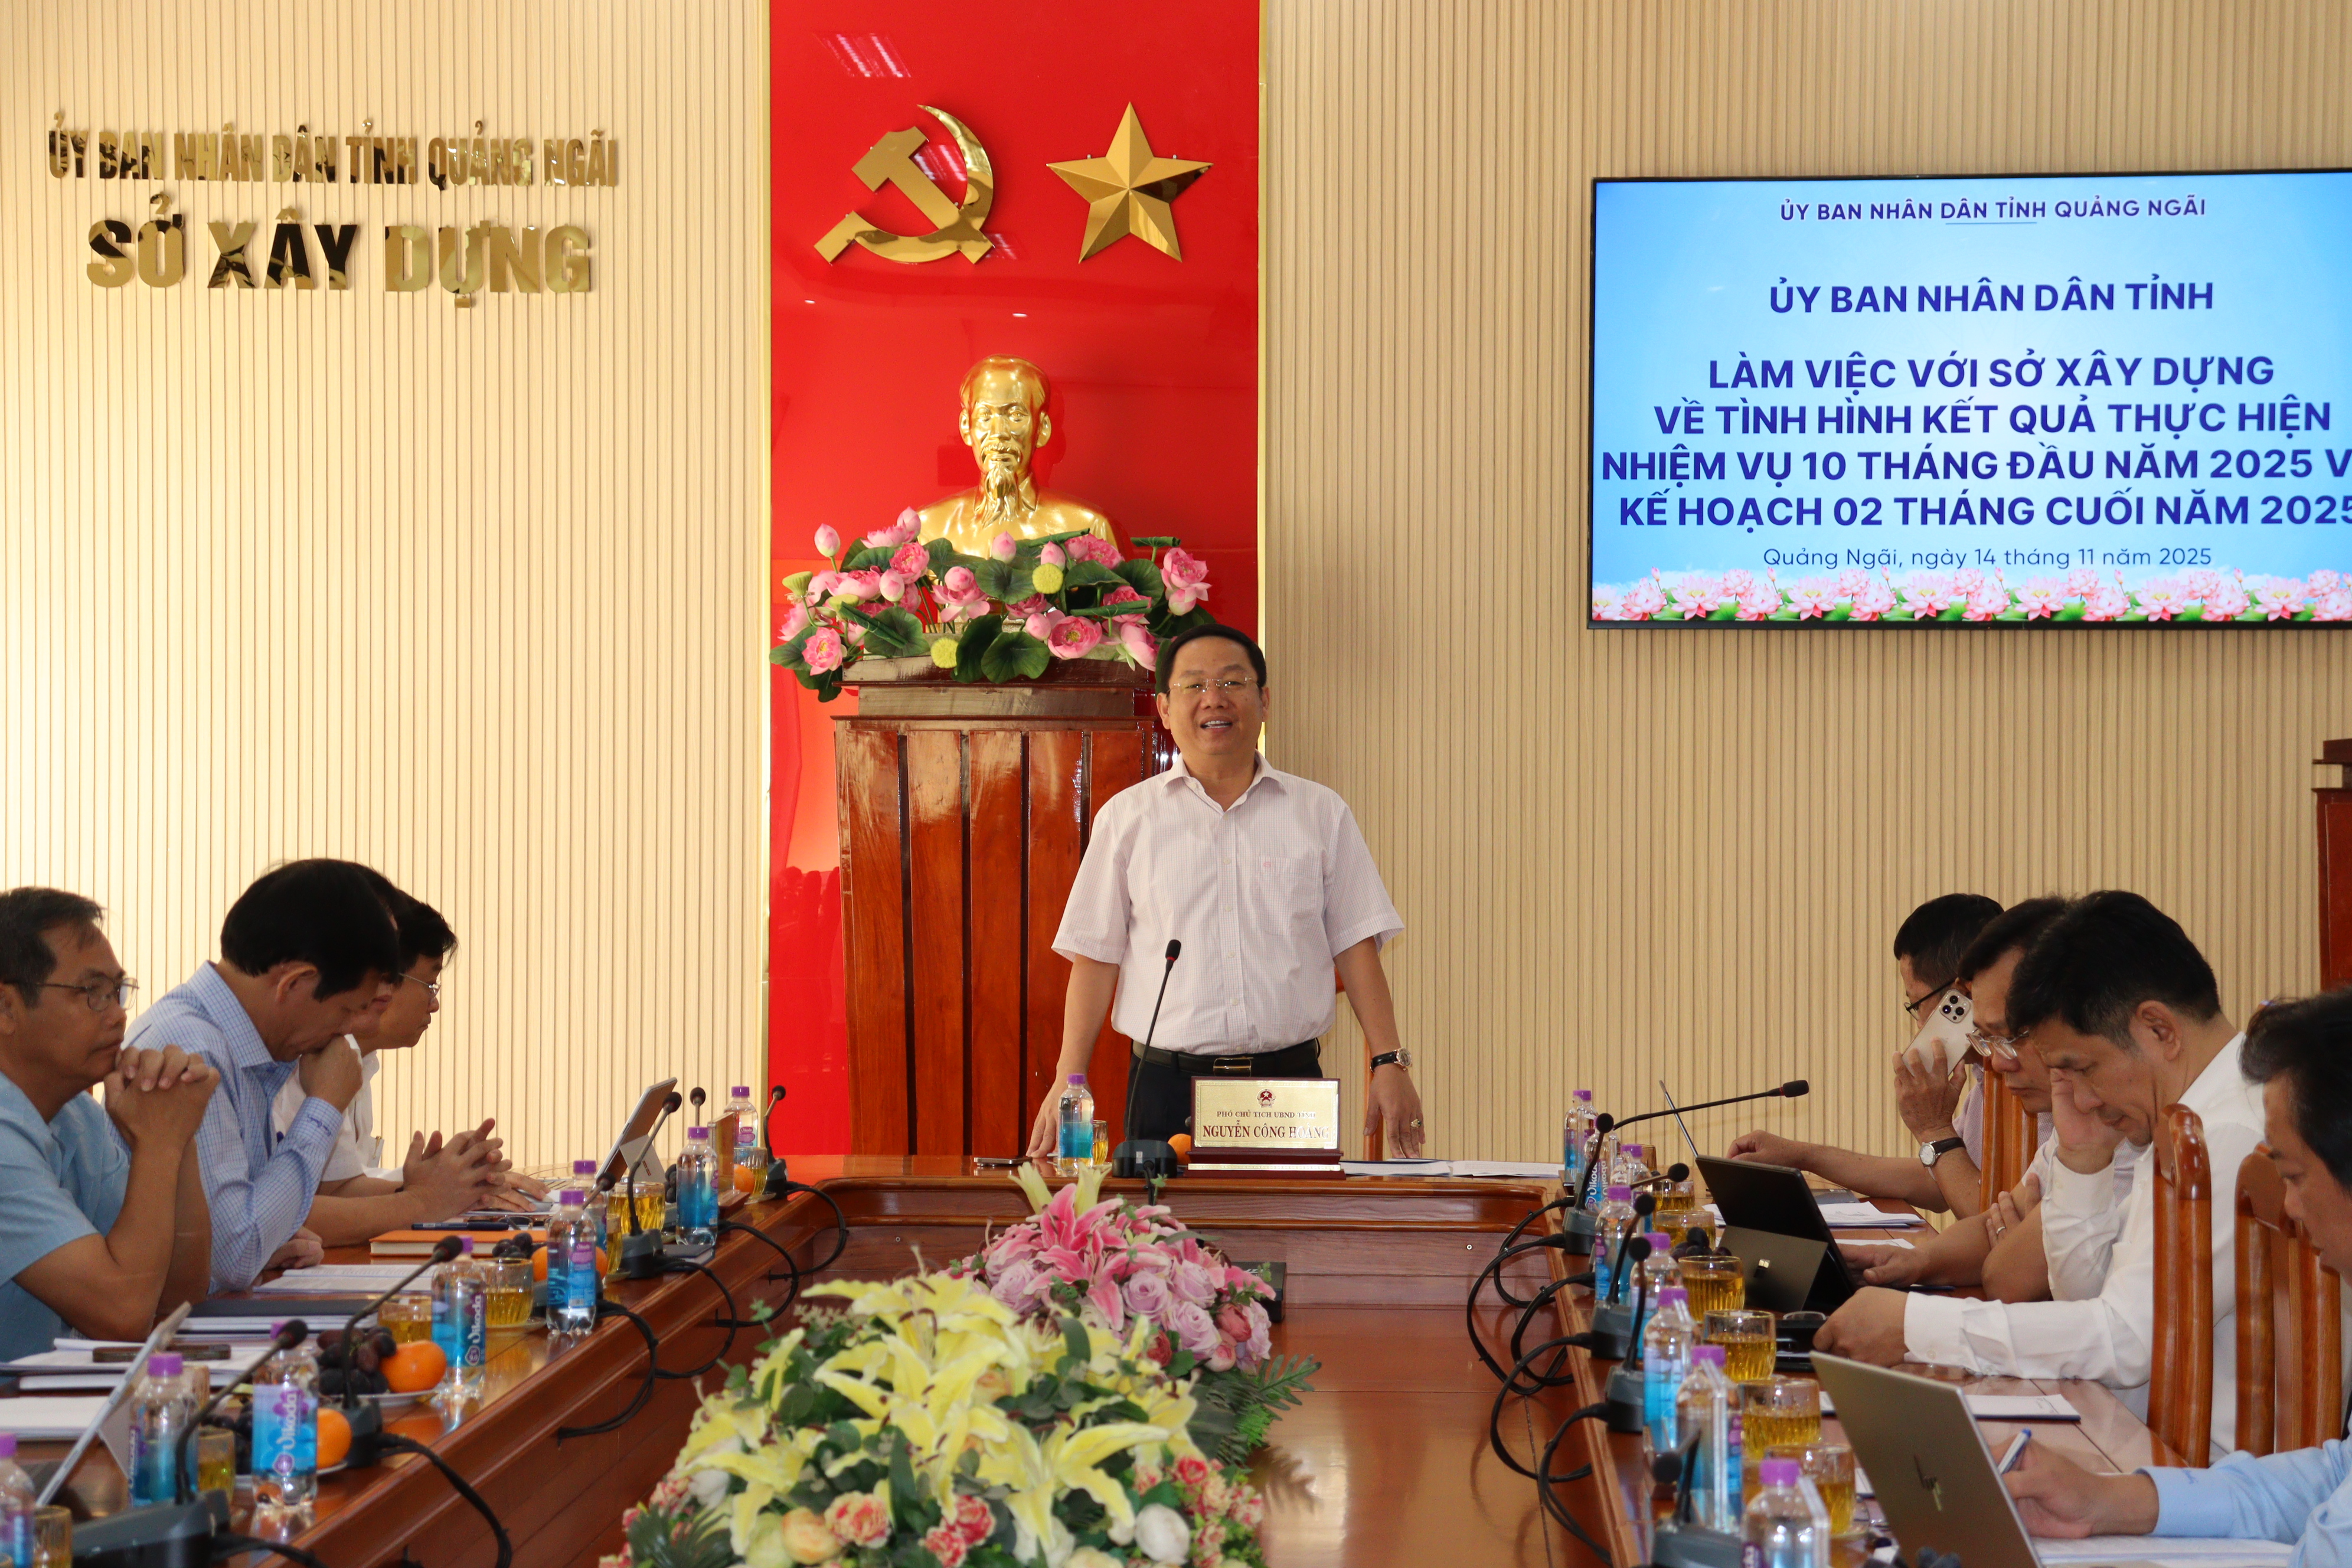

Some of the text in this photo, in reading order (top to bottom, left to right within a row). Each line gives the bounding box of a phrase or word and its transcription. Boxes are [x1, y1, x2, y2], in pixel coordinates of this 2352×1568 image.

[49, 112, 618, 191] ỦY BAN NHÂN DÂN TỈNH QUẢNG NGÃI
[1781, 195, 2205, 221] ỦY BAN NHÂN DÂN TỈNH QUẢNG NGÃI
[87, 193, 590, 308] SỞ XÂY DỰNG
[1770, 273, 2213, 313] ỦY BAN NHÂN DÂN TỈNH
[1710, 348, 2273, 396] LÀM VIỆC VỚI SỞ XÂY DỰNG
[1654, 394, 2330, 440] VỀ TÌNH HÌNH KẾT QUẢ THỰC HIỆN
[1602, 443, 1726, 488] NHIỆM
[1736, 452, 1791, 488] VỤ
[1803, 452, 1846, 481] 10
[1857, 443, 1998, 480] THÁNG
[2006, 442, 2093, 479] ĐẦU
[2106, 443, 2198, 479] NĂM
[2210, 449, 2312, 479] 2025
[1620, 488, 1670, 527] KẾ
[1678, 496, 1821, 534] HOẠCH
[1834, 497, 1882, 526] 02
[1894, 489, 2034, 525] THÁNG
[2046, 488, 2144, 525] CUỐI
[2156, 489, 2248, 525] NĂM
[1763, 547, 2211, 569] Quảng Ngãi, ngày 14 tháng 11 năm 2025
[1203, 1120, 1329, 1139] NGUYỄN CÔNG HOÀNG
[1235, 1109, 1251, 1118] CHỦ
